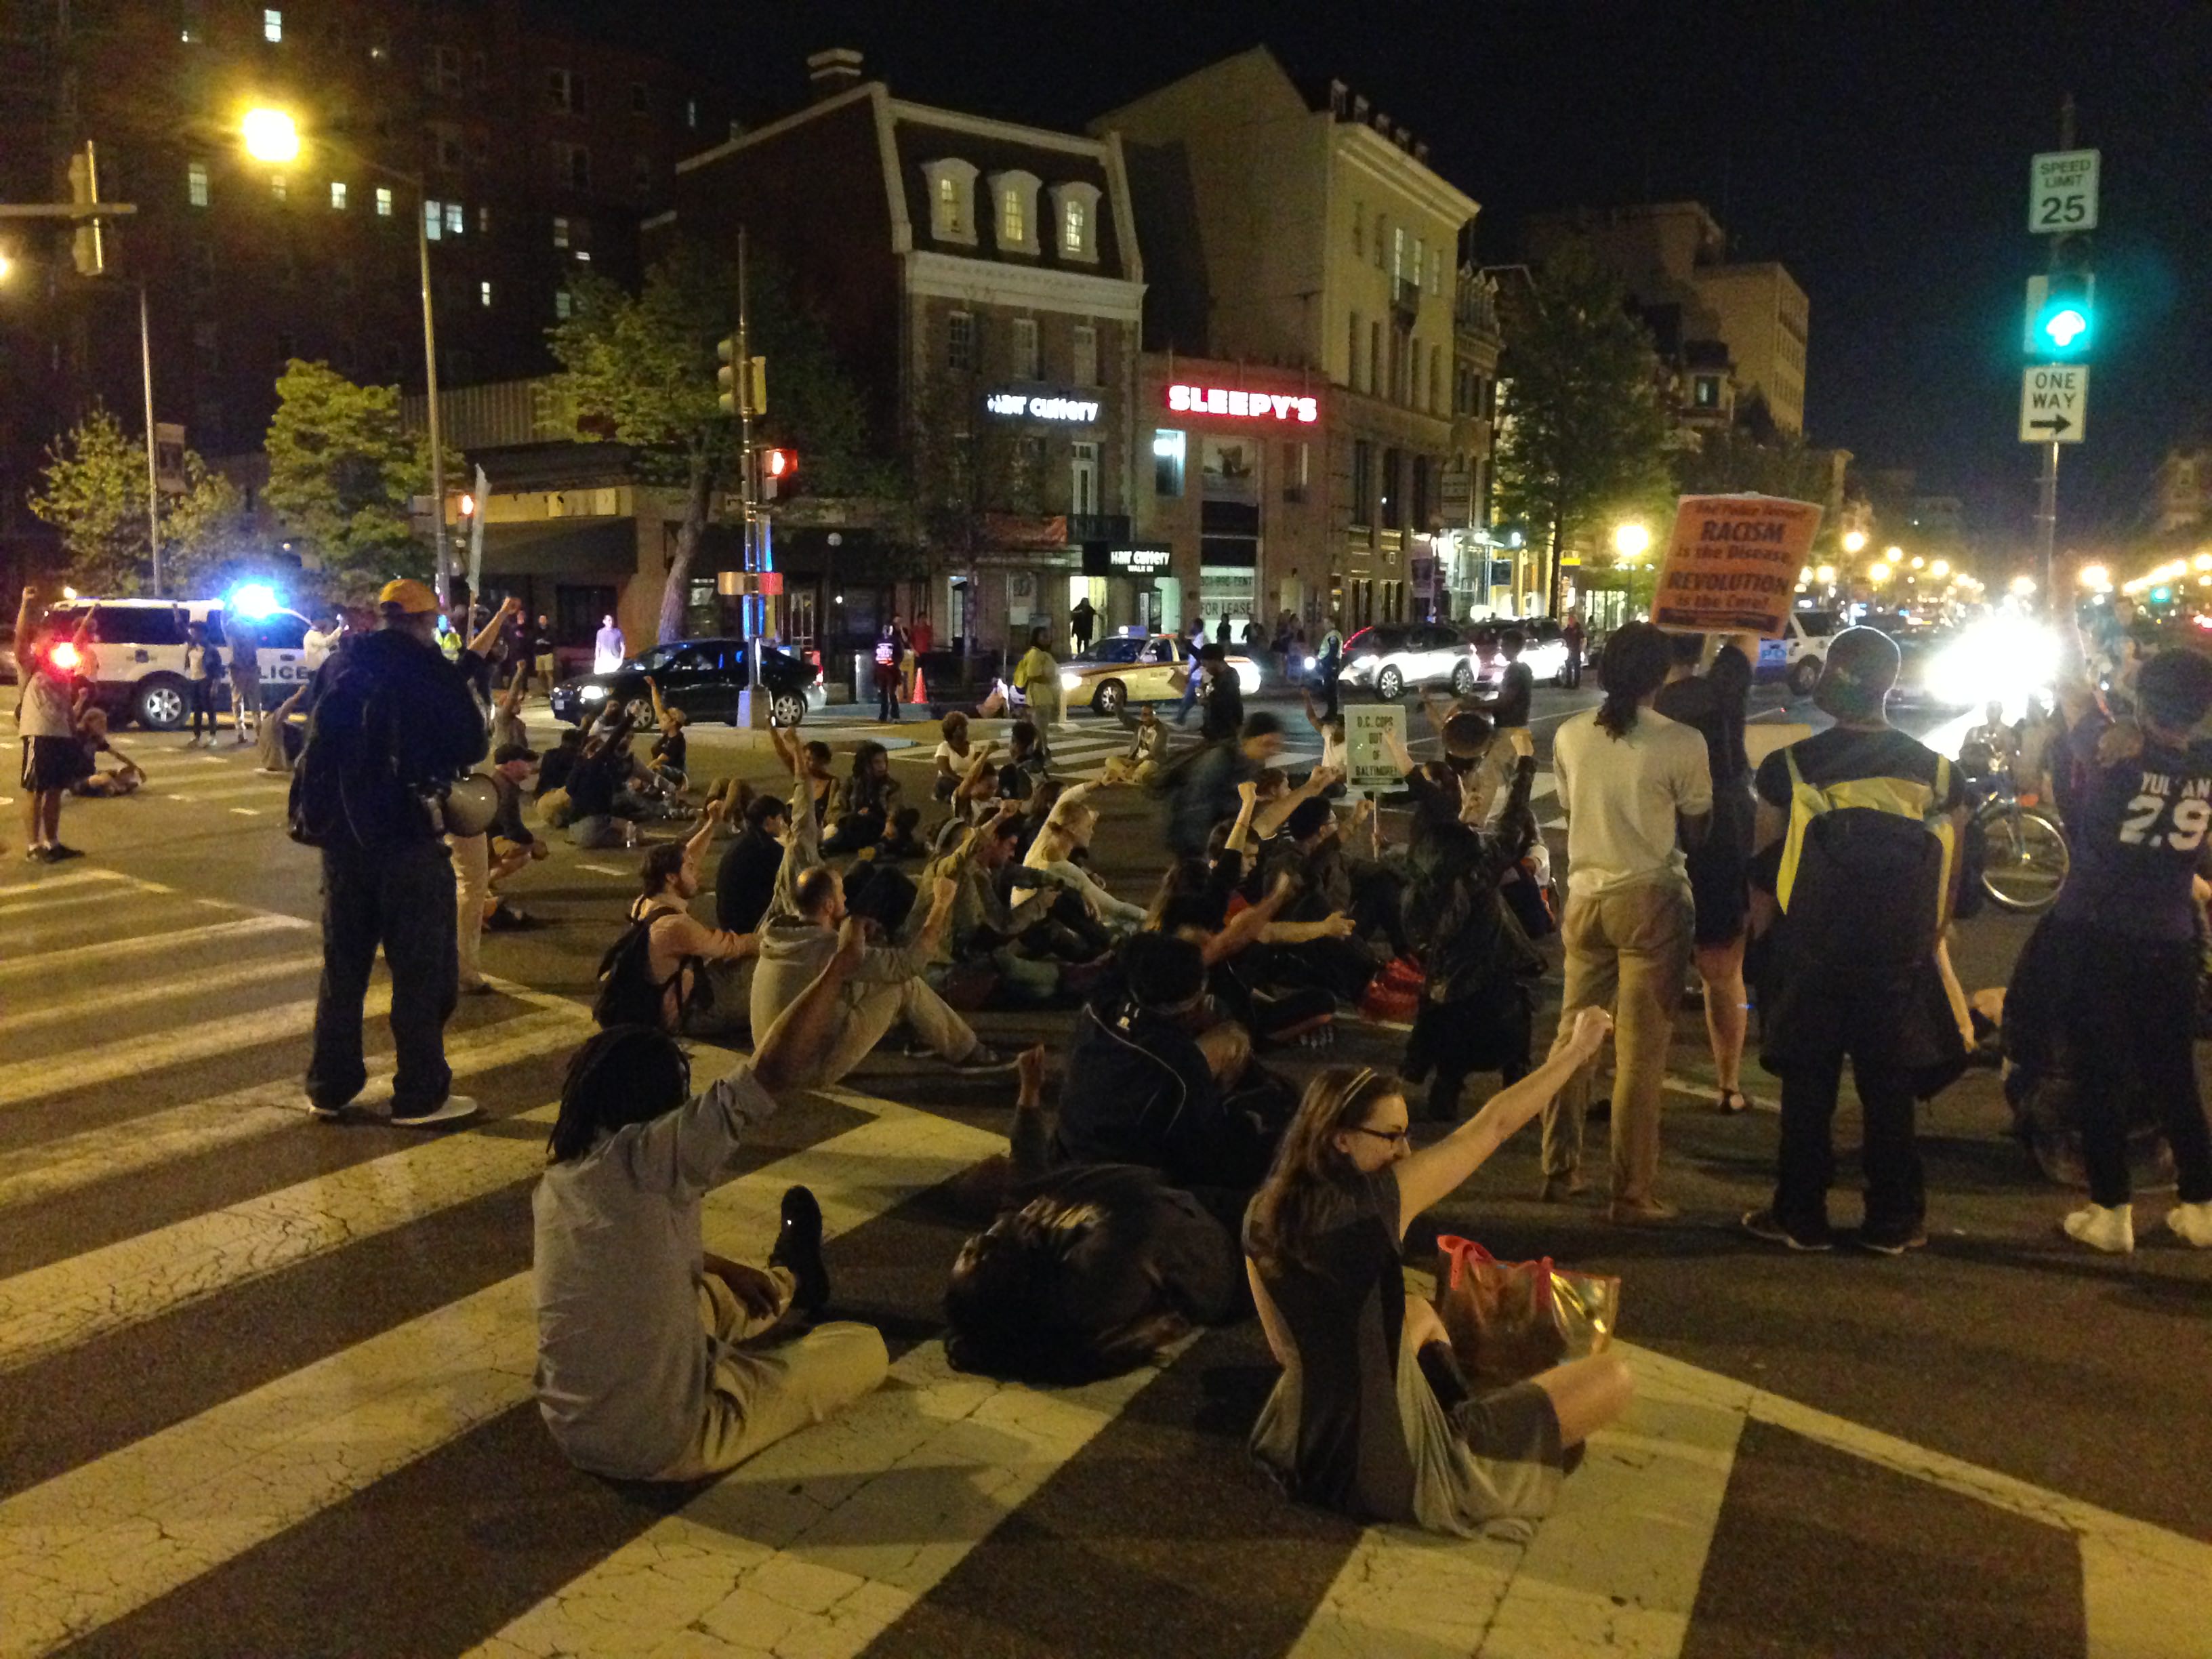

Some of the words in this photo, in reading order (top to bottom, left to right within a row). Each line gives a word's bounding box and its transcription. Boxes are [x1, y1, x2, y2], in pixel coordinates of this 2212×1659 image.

[2040, 159, 2091, 175] SPEED
[2045, 174, 2083, 188] LIMIT
[2041, 195, 2085, 224] 25
[2035, 372, 2076, 389] ONE
[1168, 384, 1318, 423] SLEEPY'S
[2032, 392, 2077, 409] WAY
[1701, 520, 1786, 543] RACISM
[1675, 544, 1690, 557] is
[1695, 545, 1723, 559] the
[1667, 571, 1789, 596] REVOLUTION
[1200, 602, 1218, 615] FOR
[1694, 594, 1720, 608] the
[1369, 732, 1382, 744] OUT
[2119, 794, 2212, 851] 29
